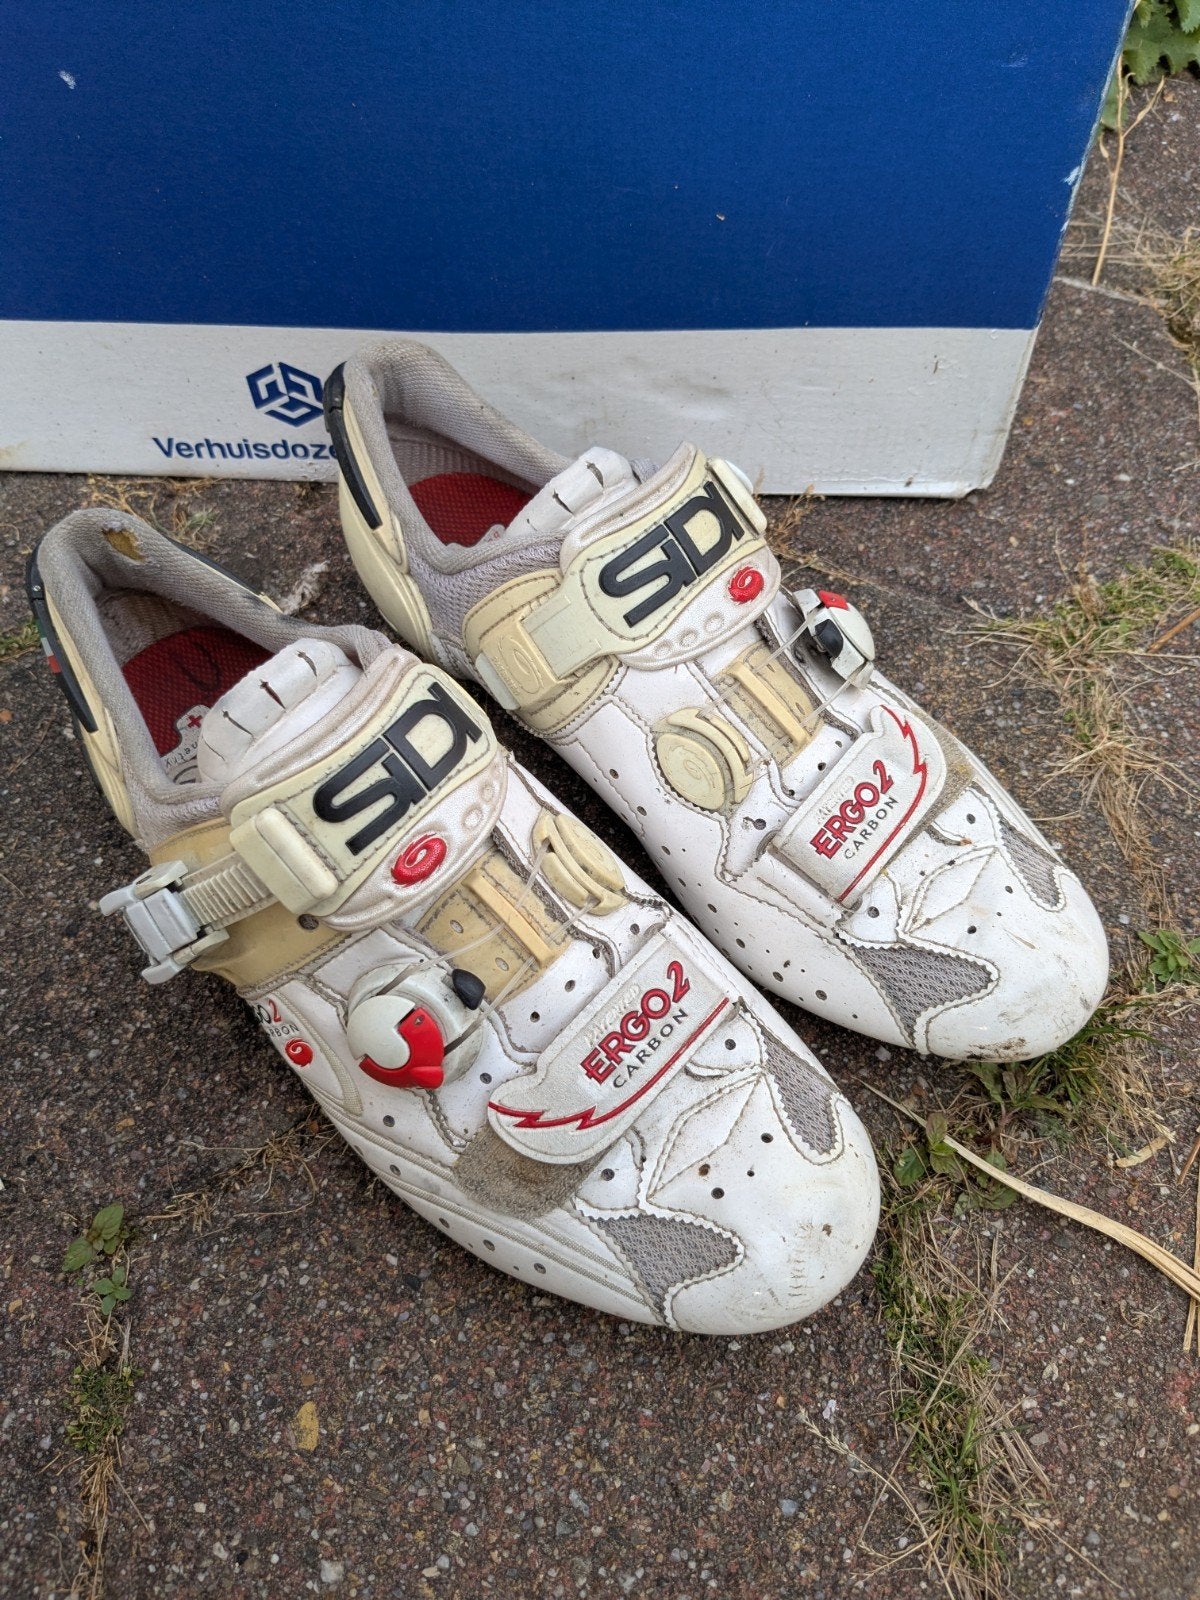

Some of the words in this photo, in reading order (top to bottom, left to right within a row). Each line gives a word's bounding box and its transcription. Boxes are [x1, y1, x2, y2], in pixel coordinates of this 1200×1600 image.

[598, 480, 746, 629] SIDI
[312, 681, 483, 856] SIDI
[809, 759, 895, 860] ERGO2
[843, 796, 898, 860] CARBON
[580, 960, 691, 1085] ERGO2
[612, 1008, 689, 1089] CARBON
